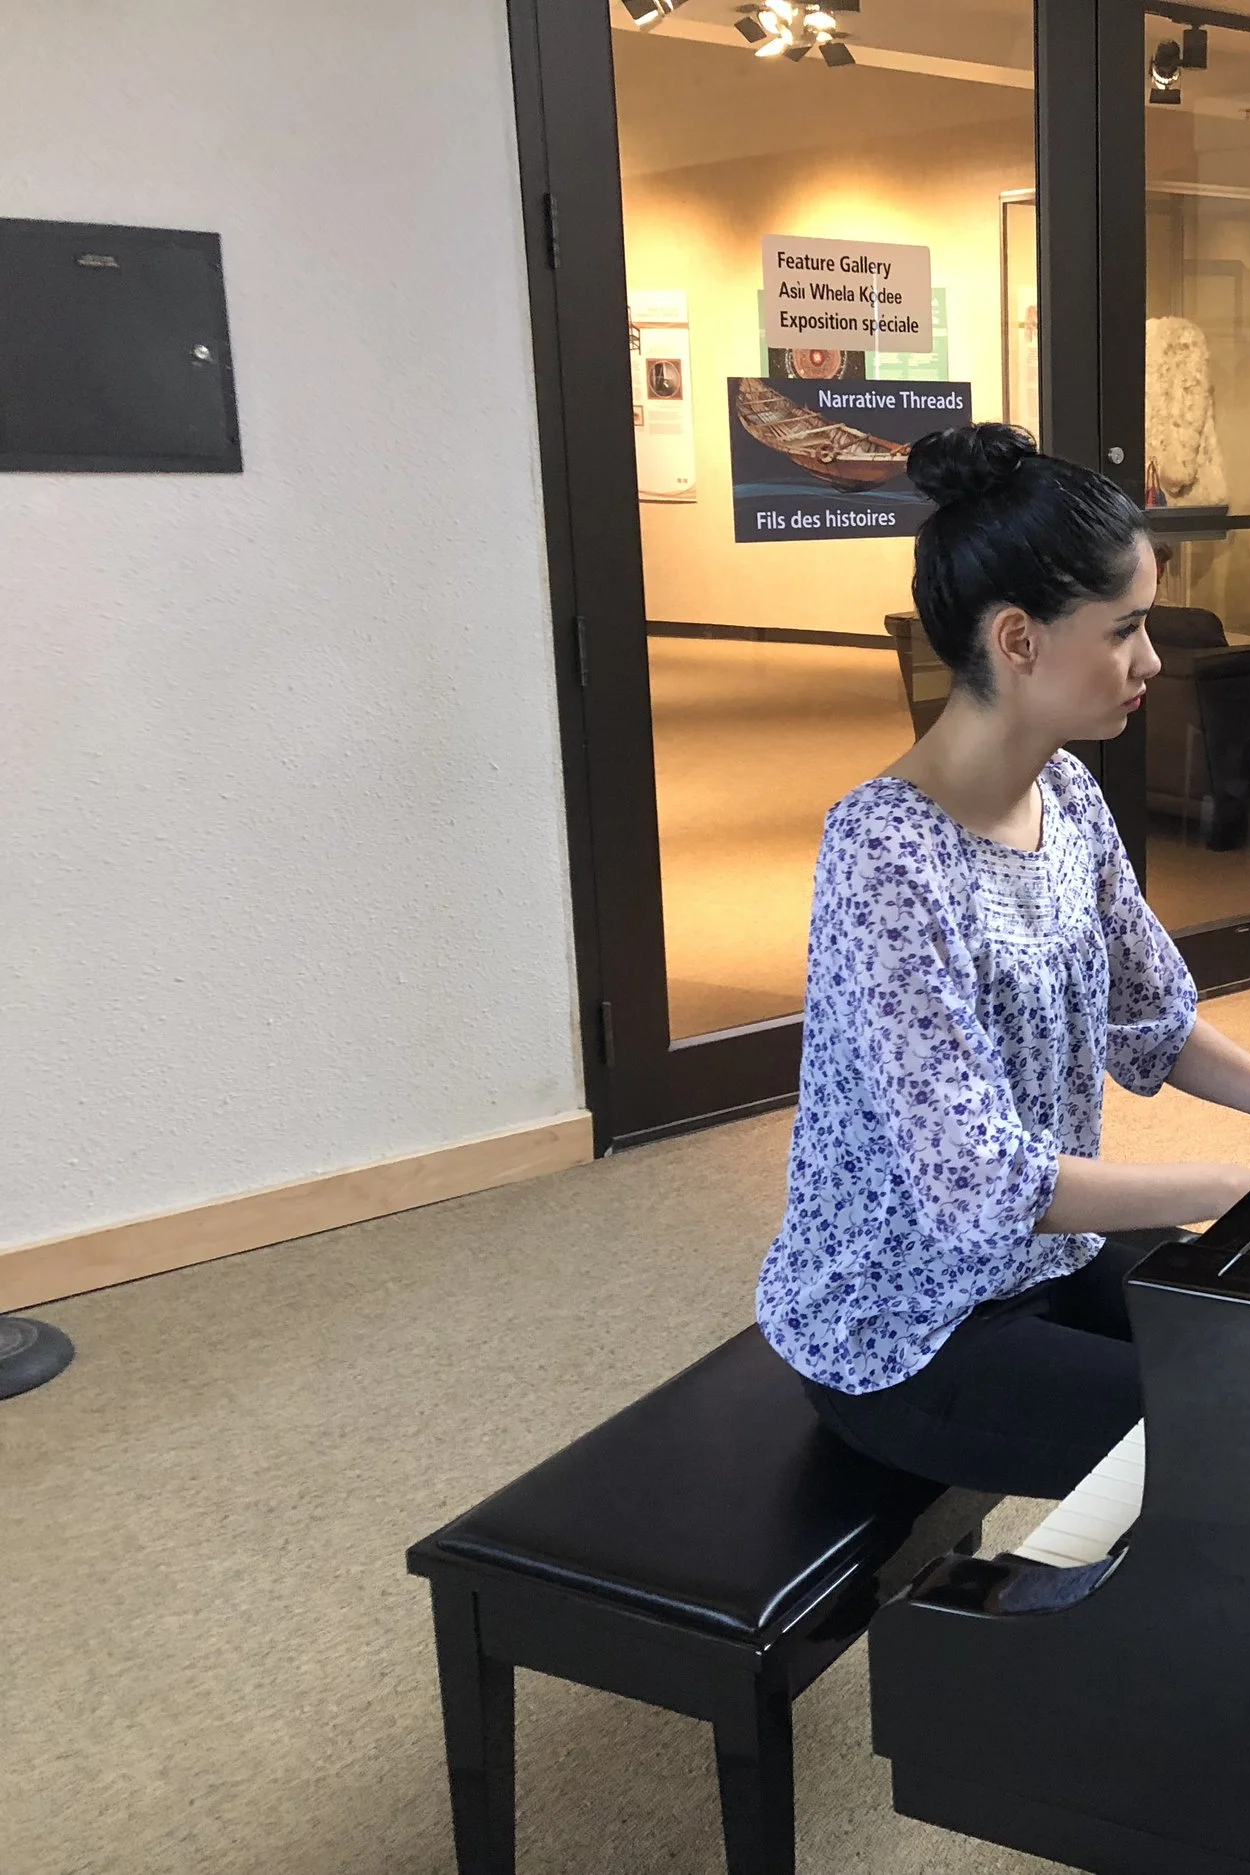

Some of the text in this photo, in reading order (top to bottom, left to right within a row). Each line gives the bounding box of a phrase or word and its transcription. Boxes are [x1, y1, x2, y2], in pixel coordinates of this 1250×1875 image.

[777, 251, 892, 280] Feature Gallery
[809, 283, 855, 302] Whela
[780, 310, 919, 336] Exposition spéciale
[818, 389, 964, 411] Narrative Threads
[756, 509, 896, 530] Fils des histoires
